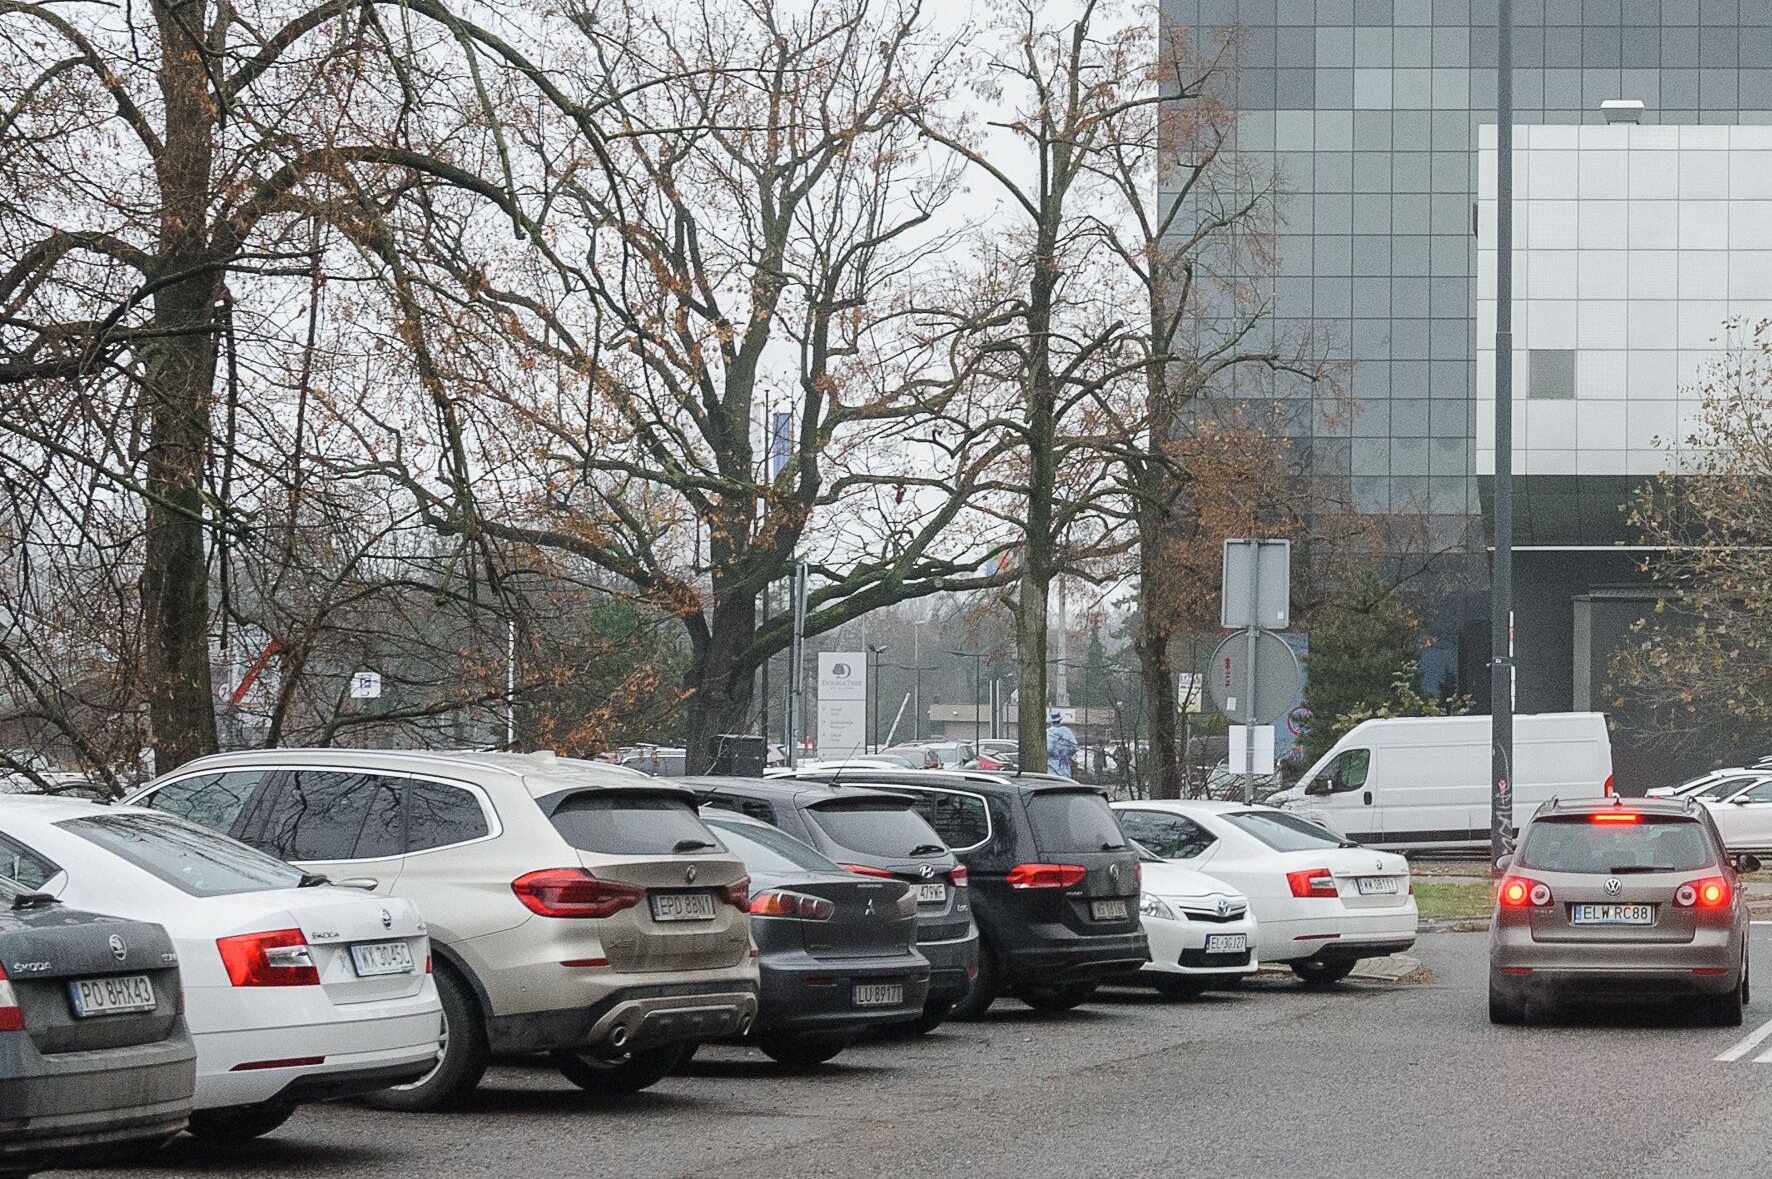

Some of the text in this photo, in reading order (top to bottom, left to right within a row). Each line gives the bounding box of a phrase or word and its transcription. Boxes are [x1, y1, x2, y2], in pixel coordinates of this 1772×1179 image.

[659, 895, 683, 916] EPD
[1584, 906, 1649, 920] ELW RC88
[105, 977, 151, 1006] 8HX43
[857, 985, 873, 1003] LU
